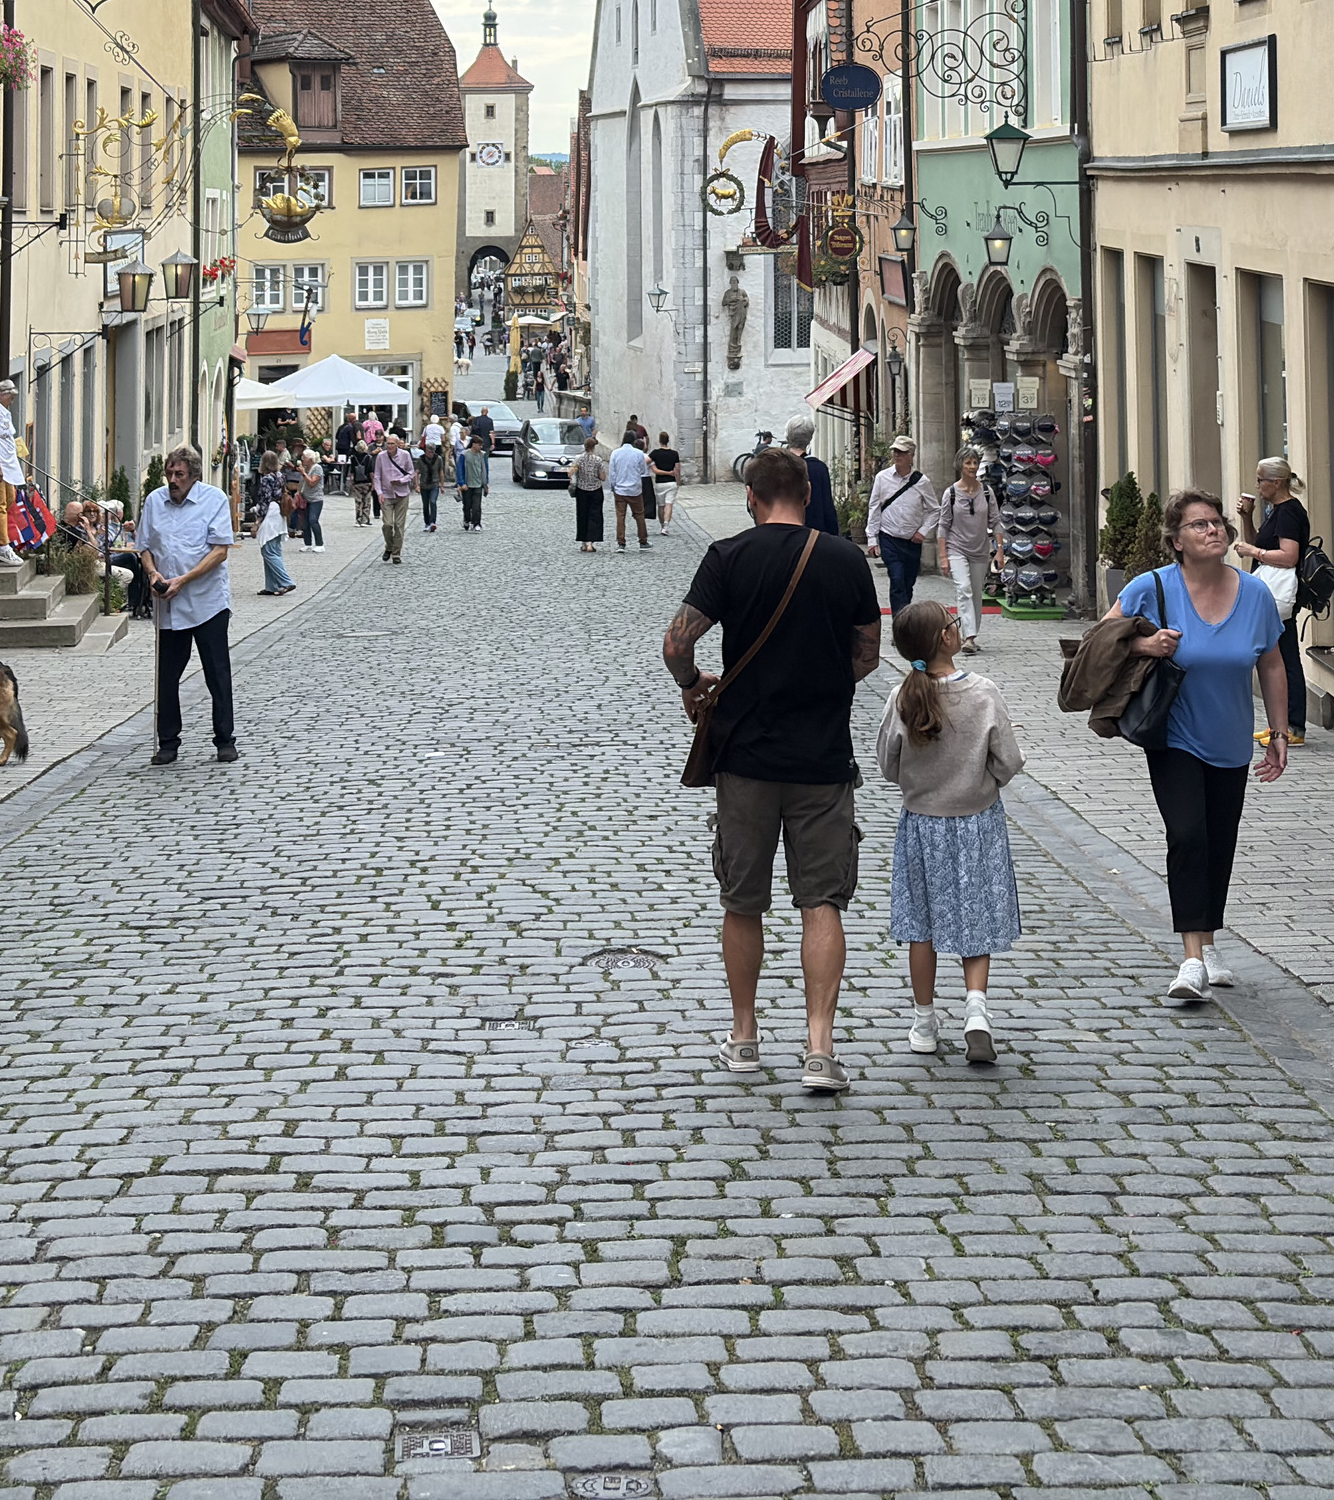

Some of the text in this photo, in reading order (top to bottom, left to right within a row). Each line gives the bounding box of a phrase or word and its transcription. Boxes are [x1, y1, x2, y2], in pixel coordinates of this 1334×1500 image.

[829, 75, 848, 85] Reeb
[1233, 47, 1266, 109] Daniels
[833, 87, 874, 98] Cristallerie
[268, 229, 304, 241] Gasthof
